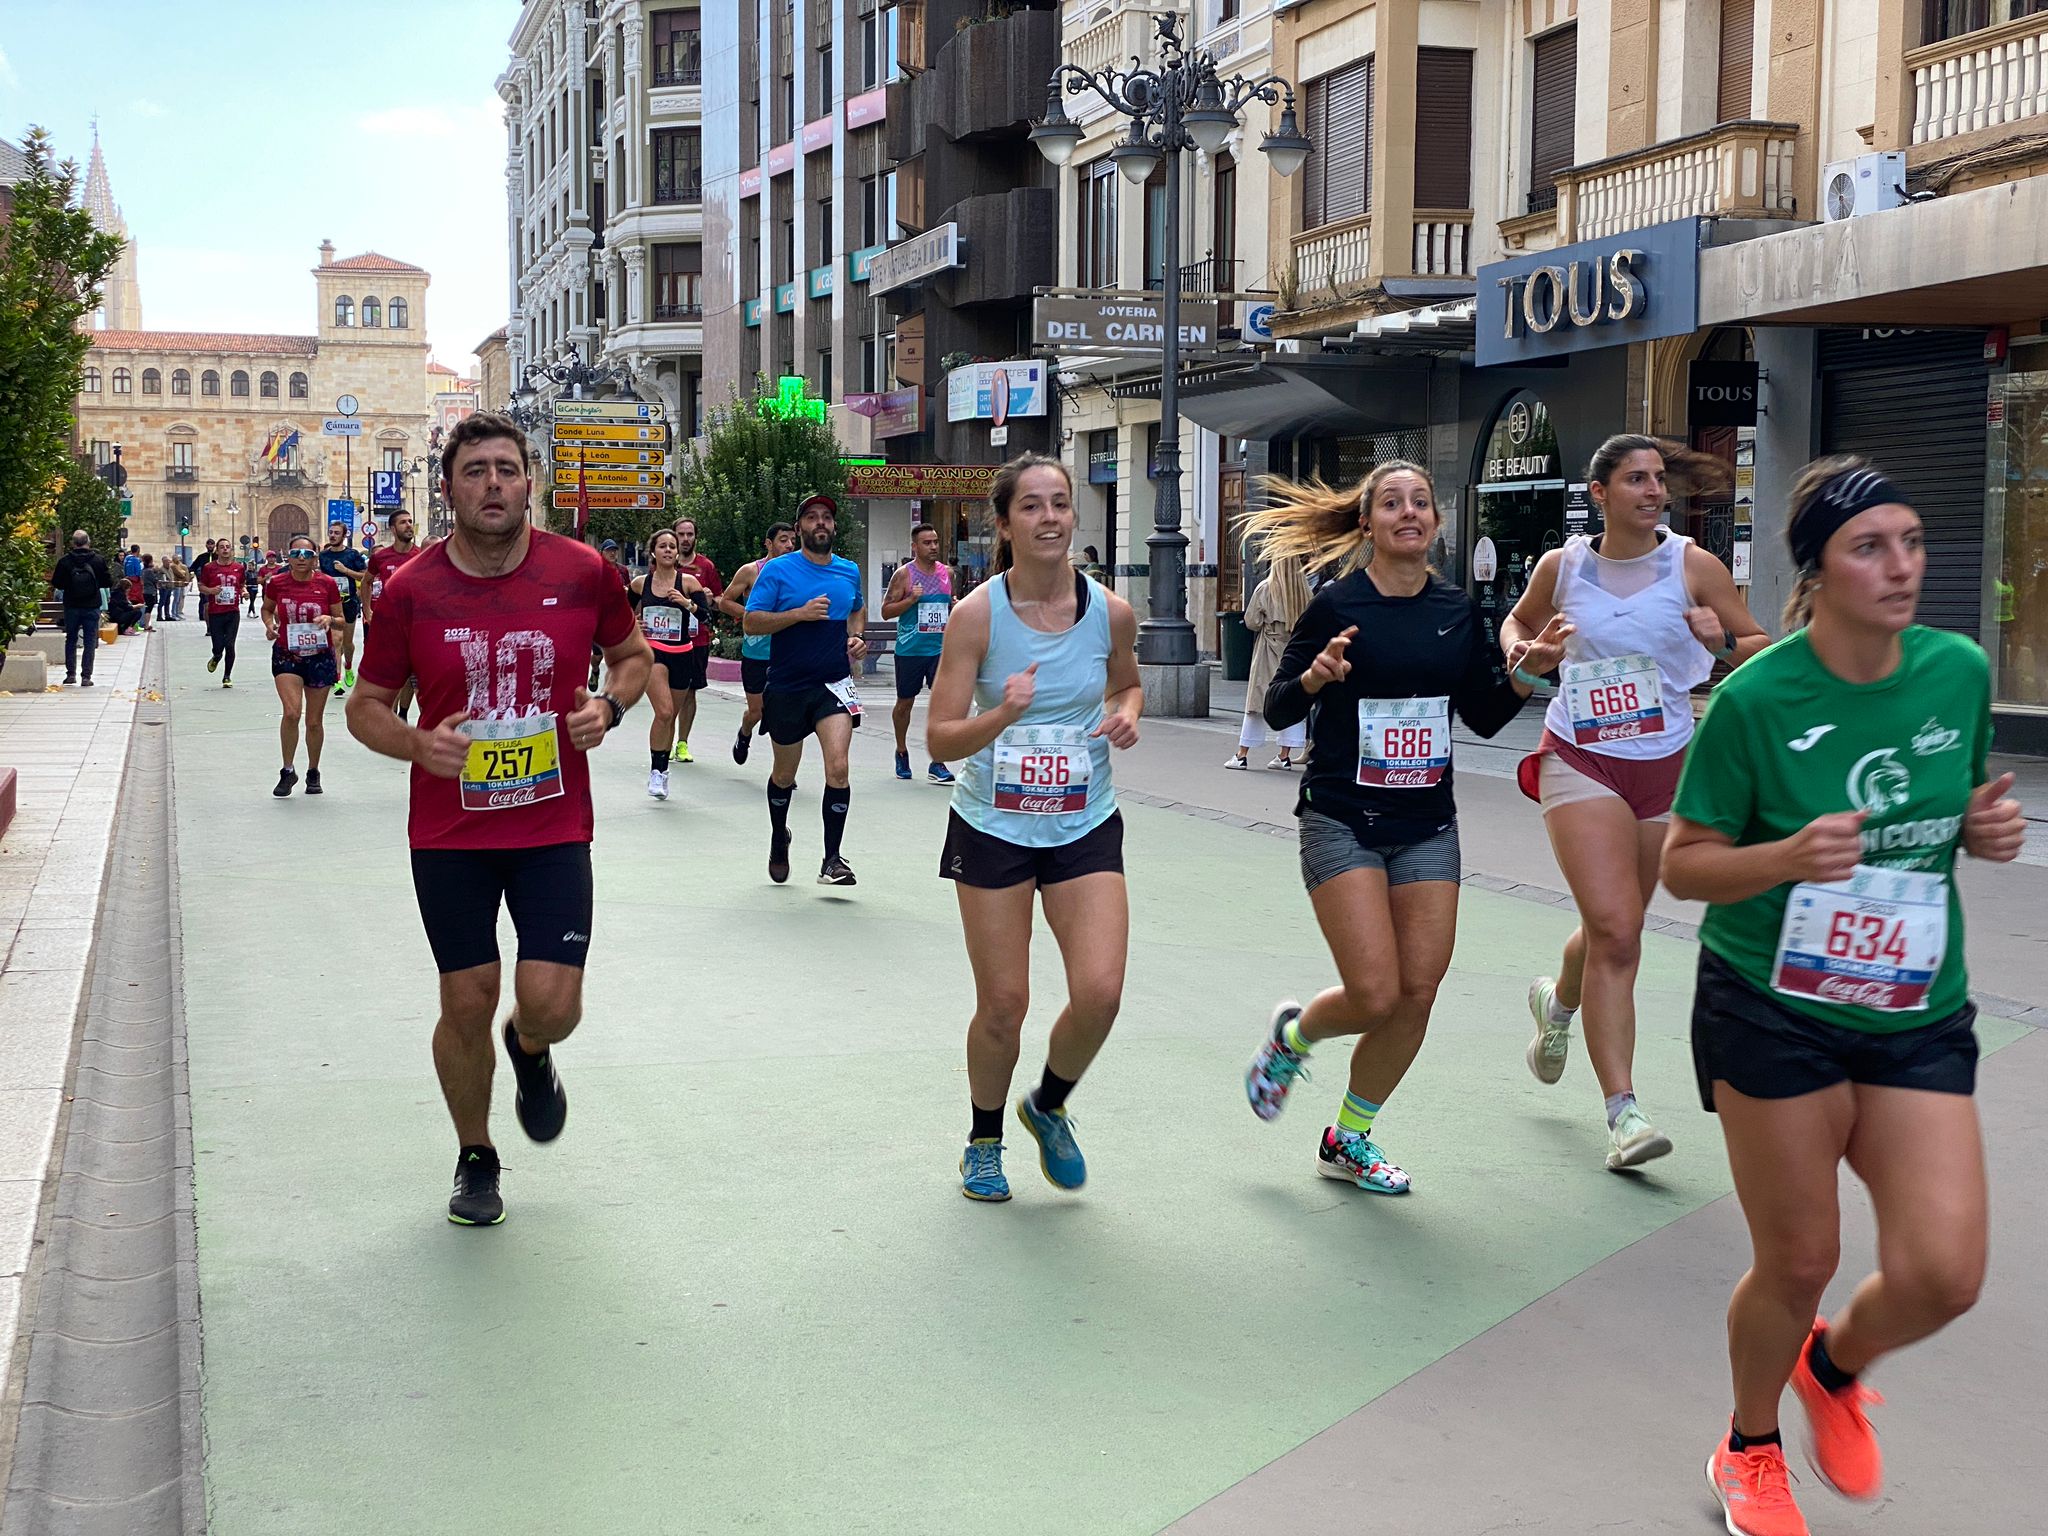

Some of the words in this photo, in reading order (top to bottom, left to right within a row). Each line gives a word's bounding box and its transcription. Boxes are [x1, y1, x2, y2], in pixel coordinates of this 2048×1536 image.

[1496, 249, 1646, 339] TOUS
[1098, 305, 1157, 318] JOYERIA
[1047, 320, 1092, 340] DEL
[1696, 385, 1753, 401] TOUS
[325, 420, 360, 431] Cámara
[1510, 414, 1526, 433] BE
[557, 450, 573, 458] Luis
[1090, 451, 1116, 464] ESTRELLA
[850, 466, 913, 478] ROYAL
[1489, 458, 1505, 478] BE
[1506, 454, 1551, 476] BEAUTY
[597, 474, 628, 482] Antonio
[928, 612, 942, 623] 391
[298, 634, 318, 646] 659
[444, 628, 470, 636] 2022
[1590, 682, 1640, 717] 668
[1384, 728, 1432, 758] 686
[483, 746, 533, 780] 257
[1020, 756, 1070, 786] 636
[1826, 910, 1908, 965] 634
